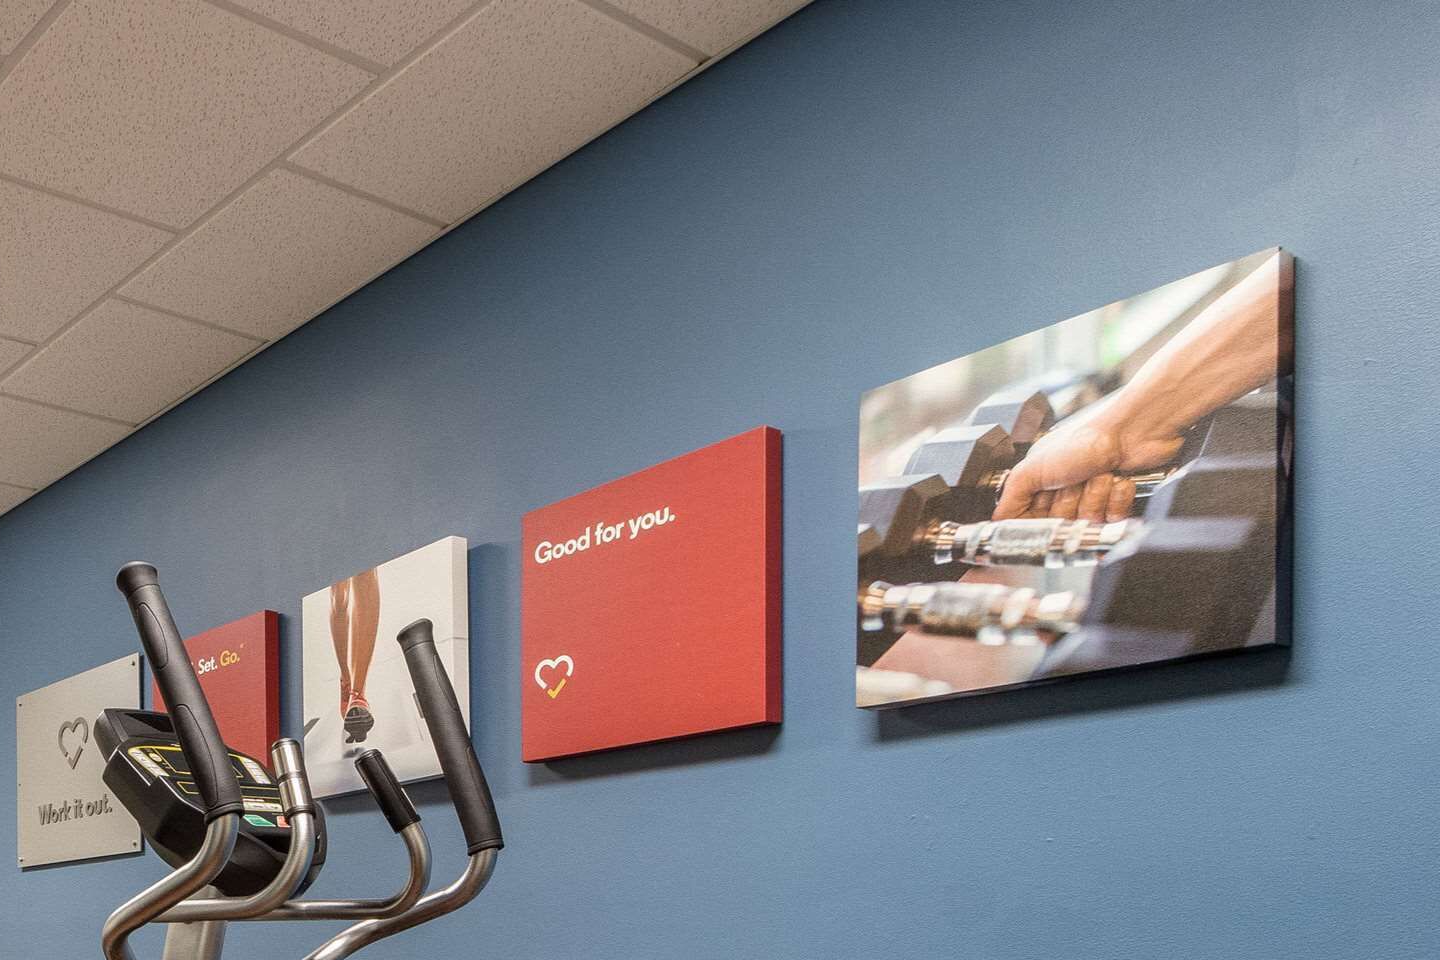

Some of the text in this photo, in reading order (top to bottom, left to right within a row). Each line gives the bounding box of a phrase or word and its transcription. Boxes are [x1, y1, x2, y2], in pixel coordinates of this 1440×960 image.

[534, 506, 676, 564] Good for you.
[198, 650, 240, 675] Set. Go.
[38, 793, 113, 826] Work it out.
